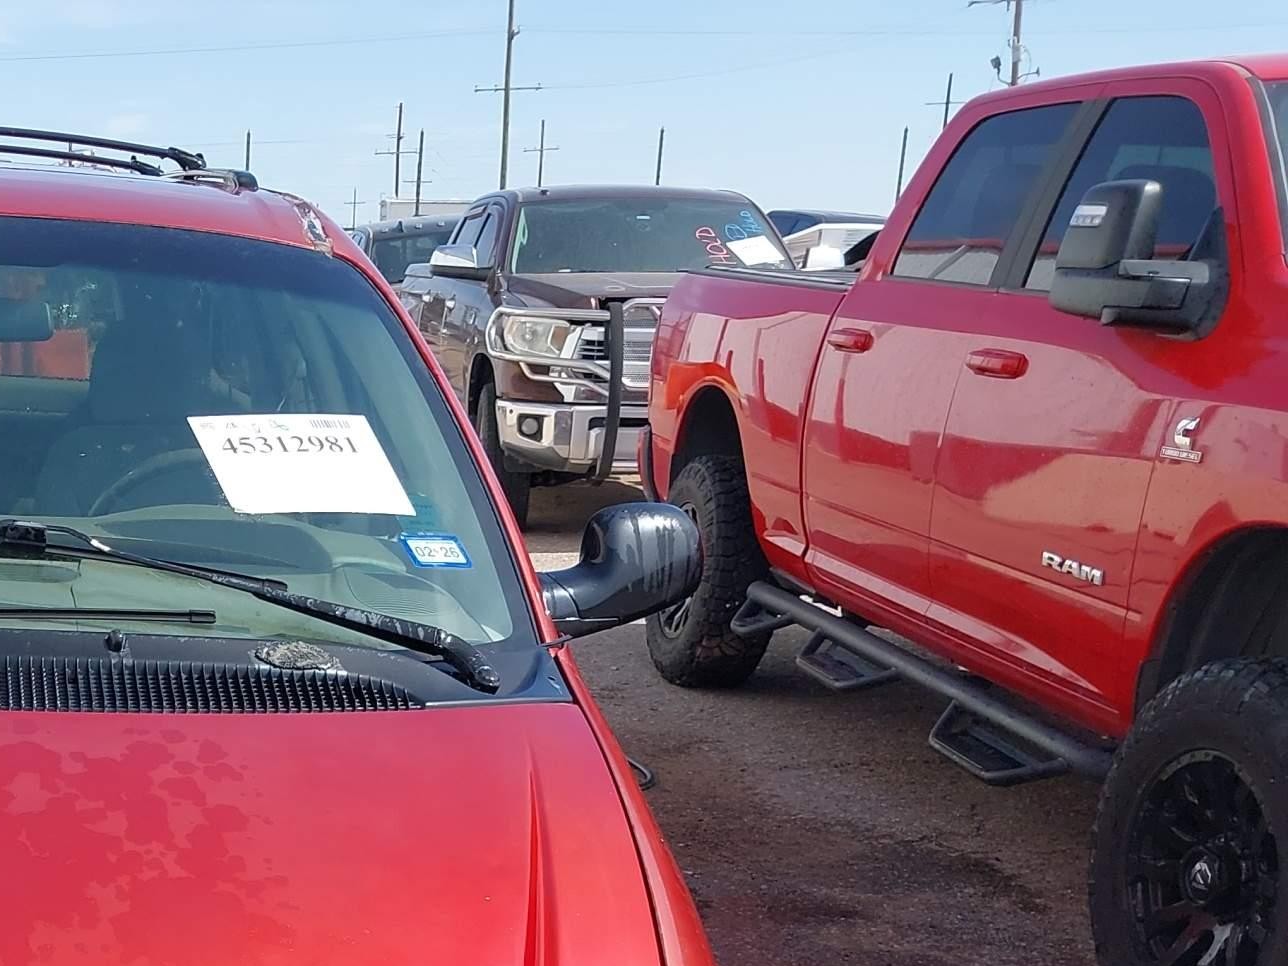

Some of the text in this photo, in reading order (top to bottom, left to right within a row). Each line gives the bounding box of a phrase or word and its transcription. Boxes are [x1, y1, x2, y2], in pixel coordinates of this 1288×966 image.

[695, 226, 737, 265] HOLD
[222, 435, 359, 454] 45312981
[1042, 551, 1103, 586] RAM
